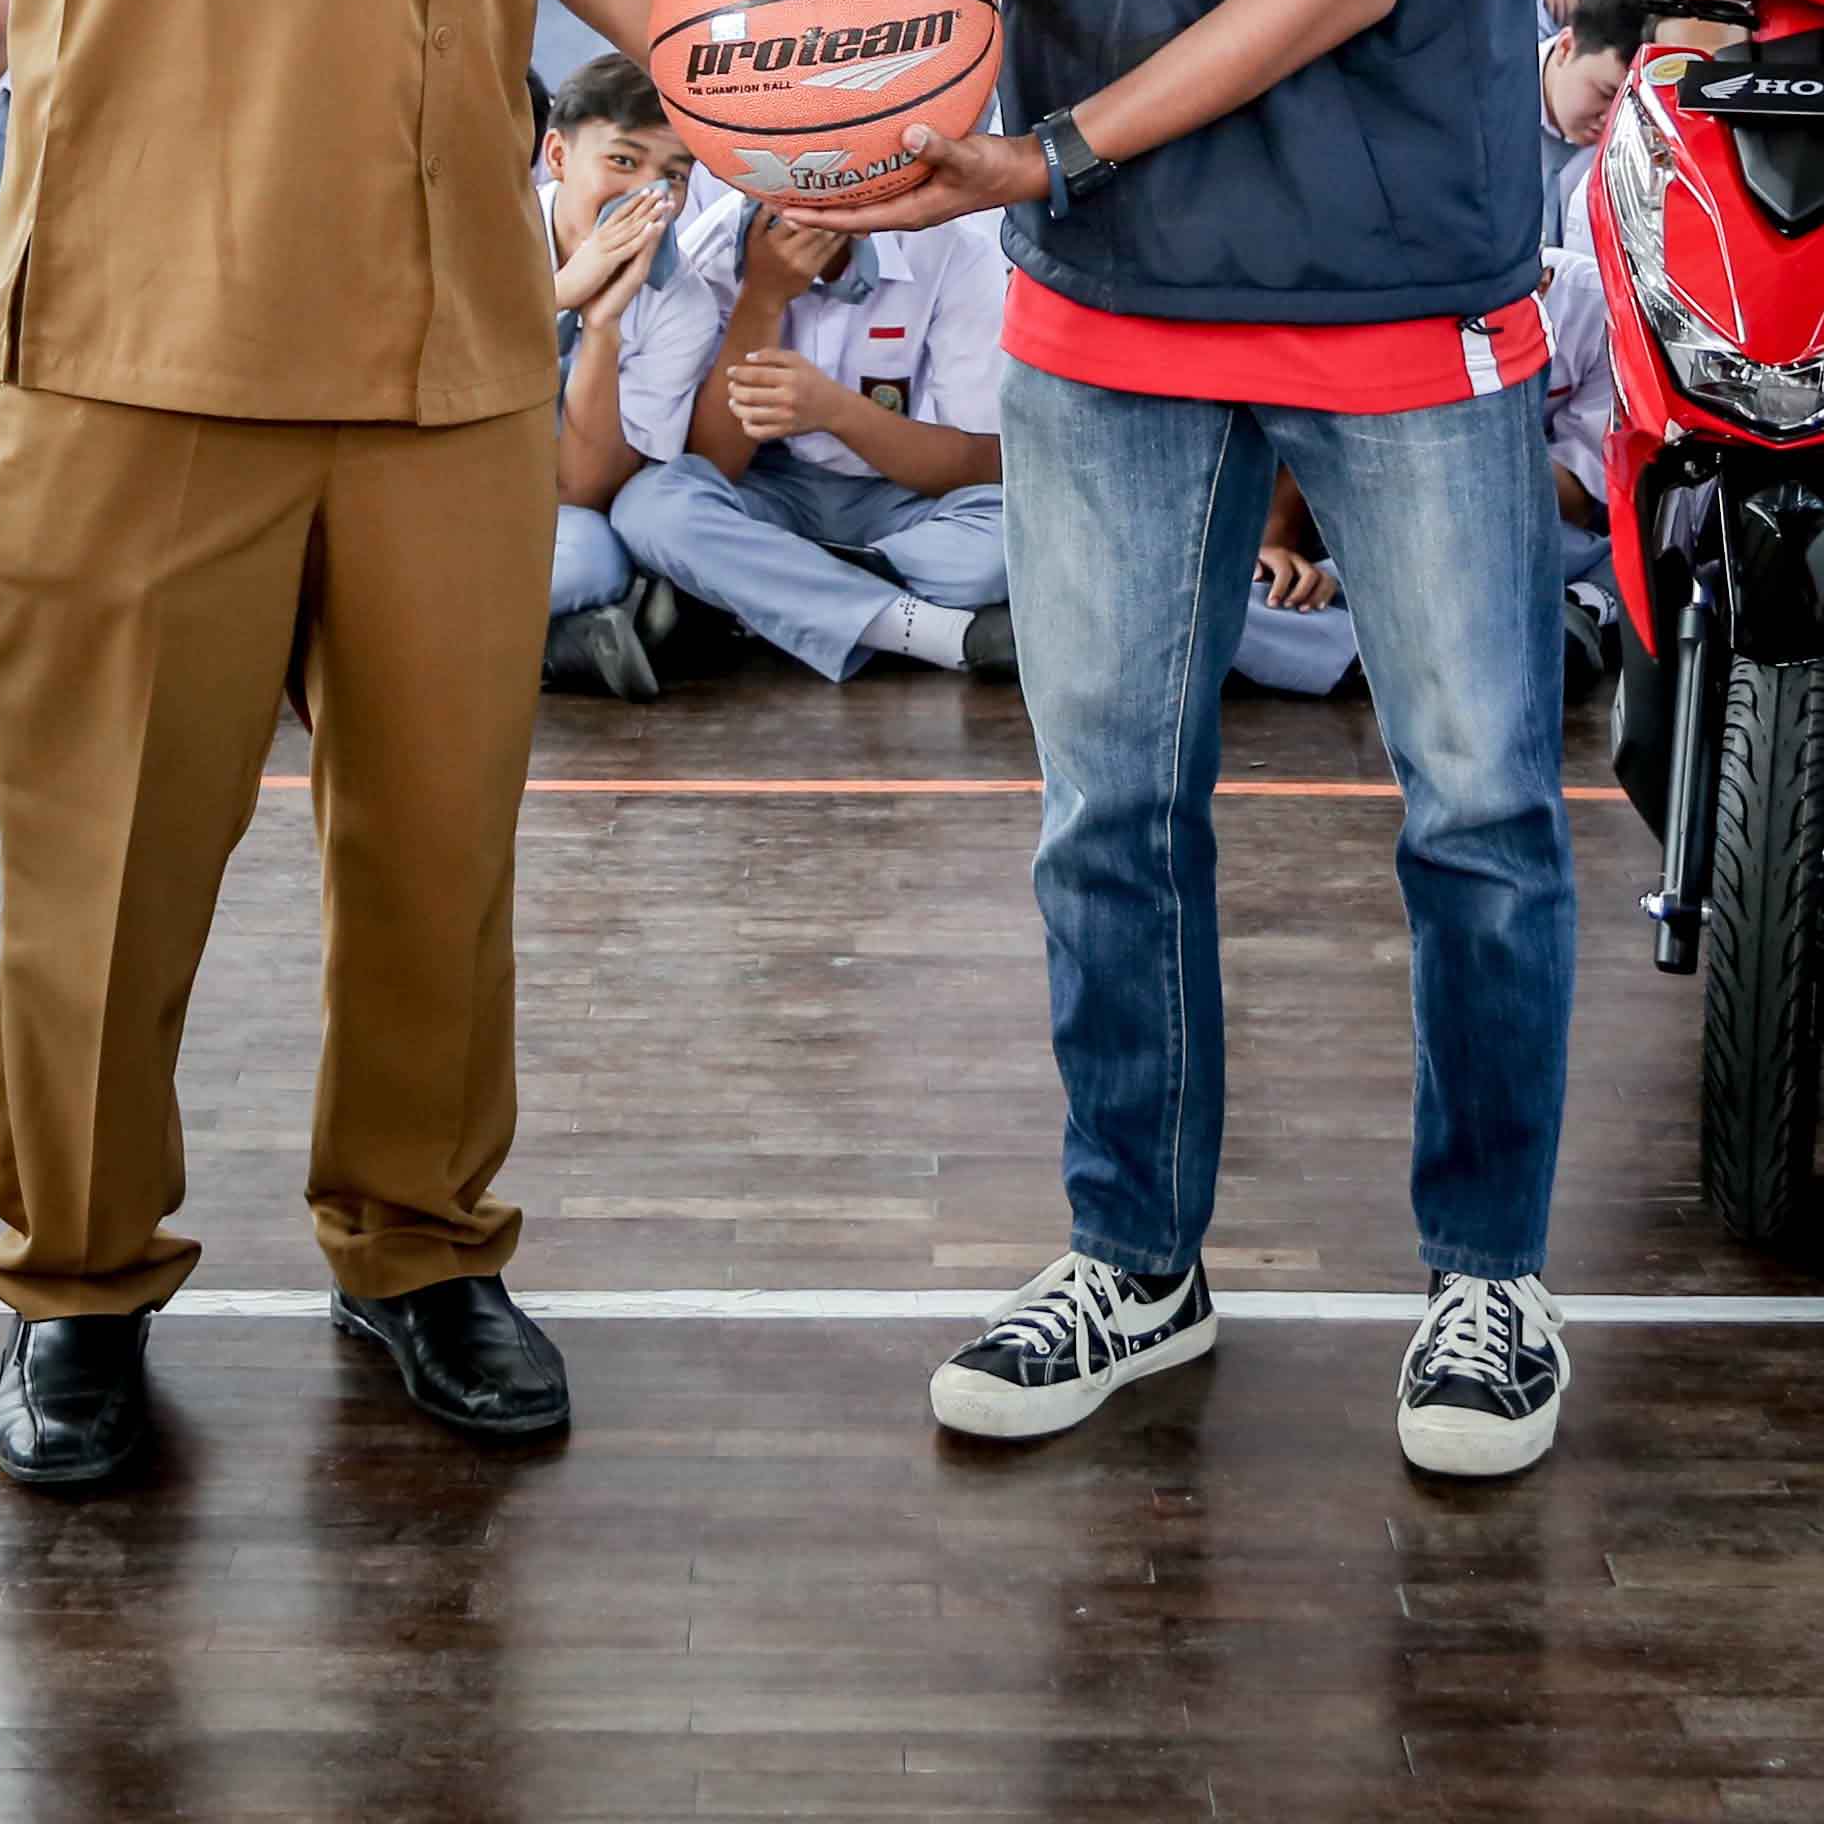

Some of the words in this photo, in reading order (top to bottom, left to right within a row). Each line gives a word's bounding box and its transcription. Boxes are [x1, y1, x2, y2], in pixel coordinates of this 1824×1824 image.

[685, 9, 954, 83] proteam
[705, 84, 759, 95] CHAMPION
[763, 81, 794, 93] BALL
